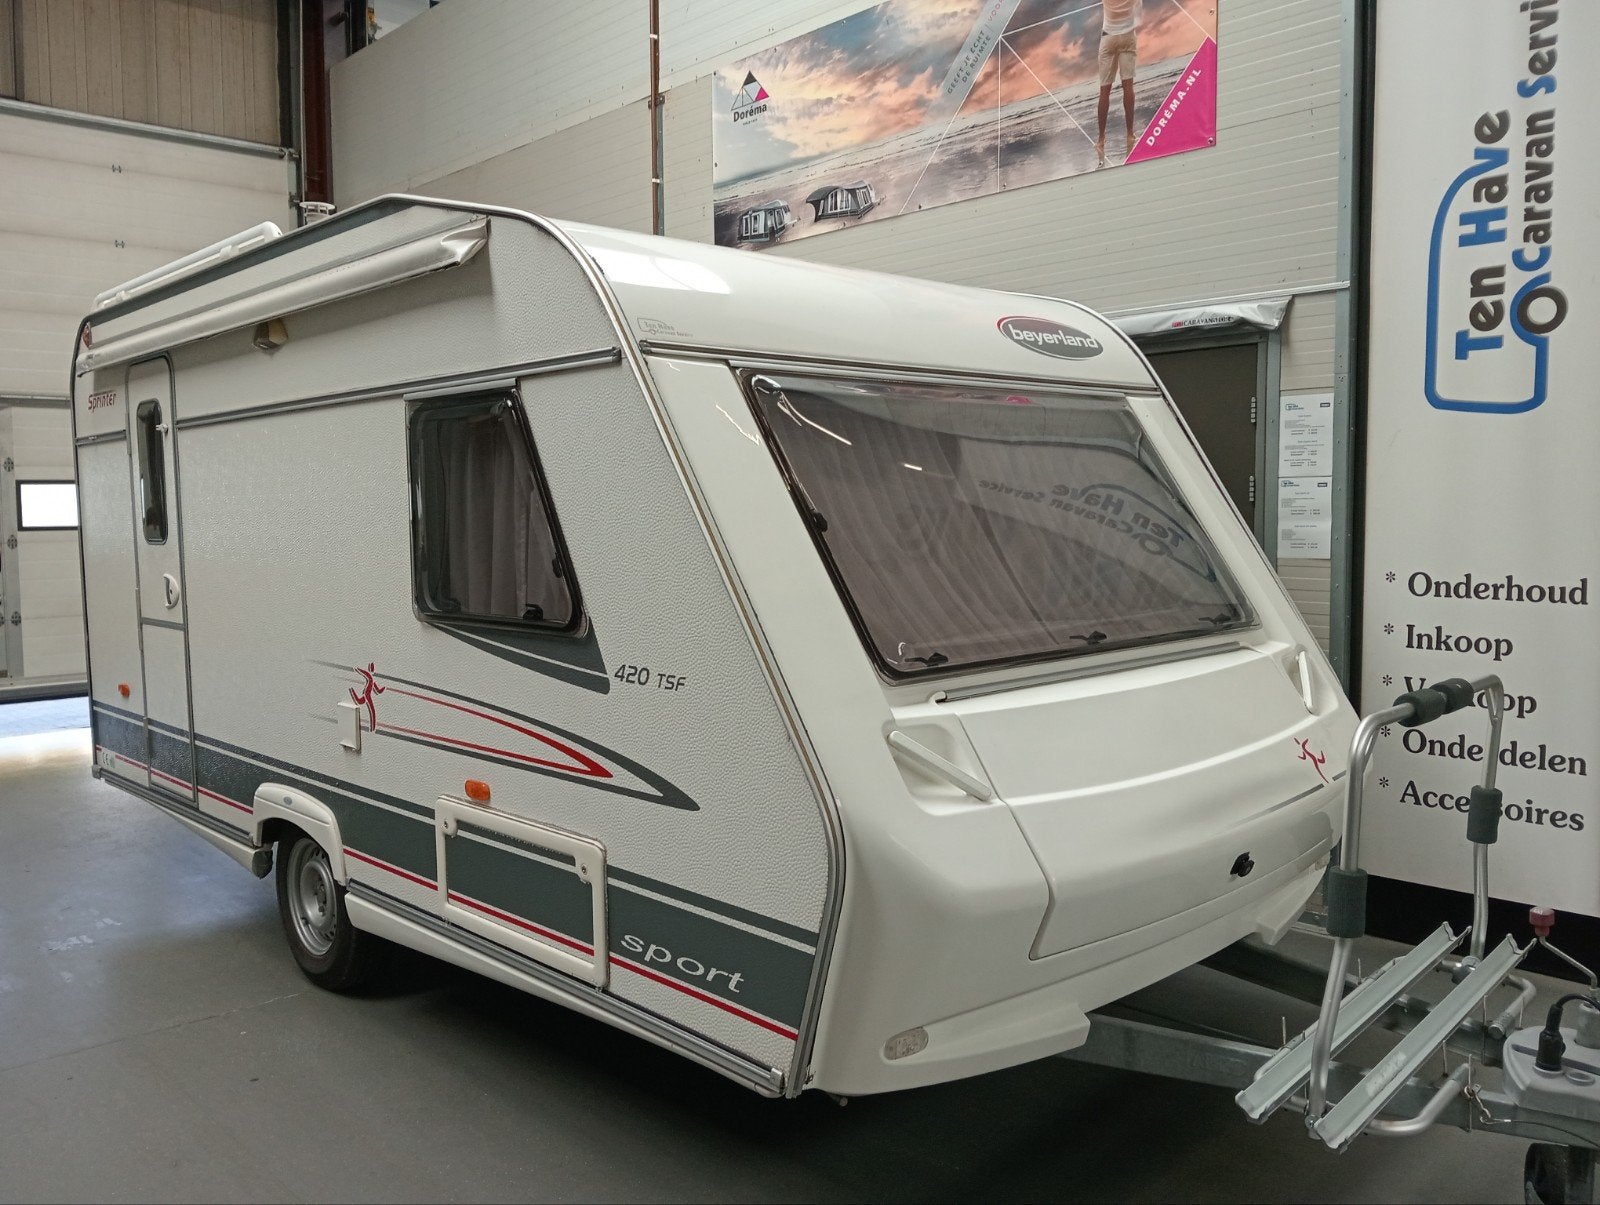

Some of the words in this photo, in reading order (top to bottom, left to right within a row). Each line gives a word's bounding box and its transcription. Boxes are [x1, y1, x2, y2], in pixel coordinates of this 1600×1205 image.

[733, 103, 767, 123] Doréma
[1458, 108, 1511, 248] Have
[1512, 108, 1557, 273] Caravan
[1455, 263, 1507, 361] Ten
[1008, 323, 1099, 349] beyerland
[87, 389, 117, 413] Sprinter
[1408, 571, 1588, 605] Onderhoud
[1405, 624, 1514, 661] Inkoop
[614, 664, 650, 686] 420
[657, 673, 687, 691] TSF
[1402, 728, 1587, 776] Ondedelen
[1399, 780, 1585, 832] Acceoires
[620, 933, 745, 993] sport
